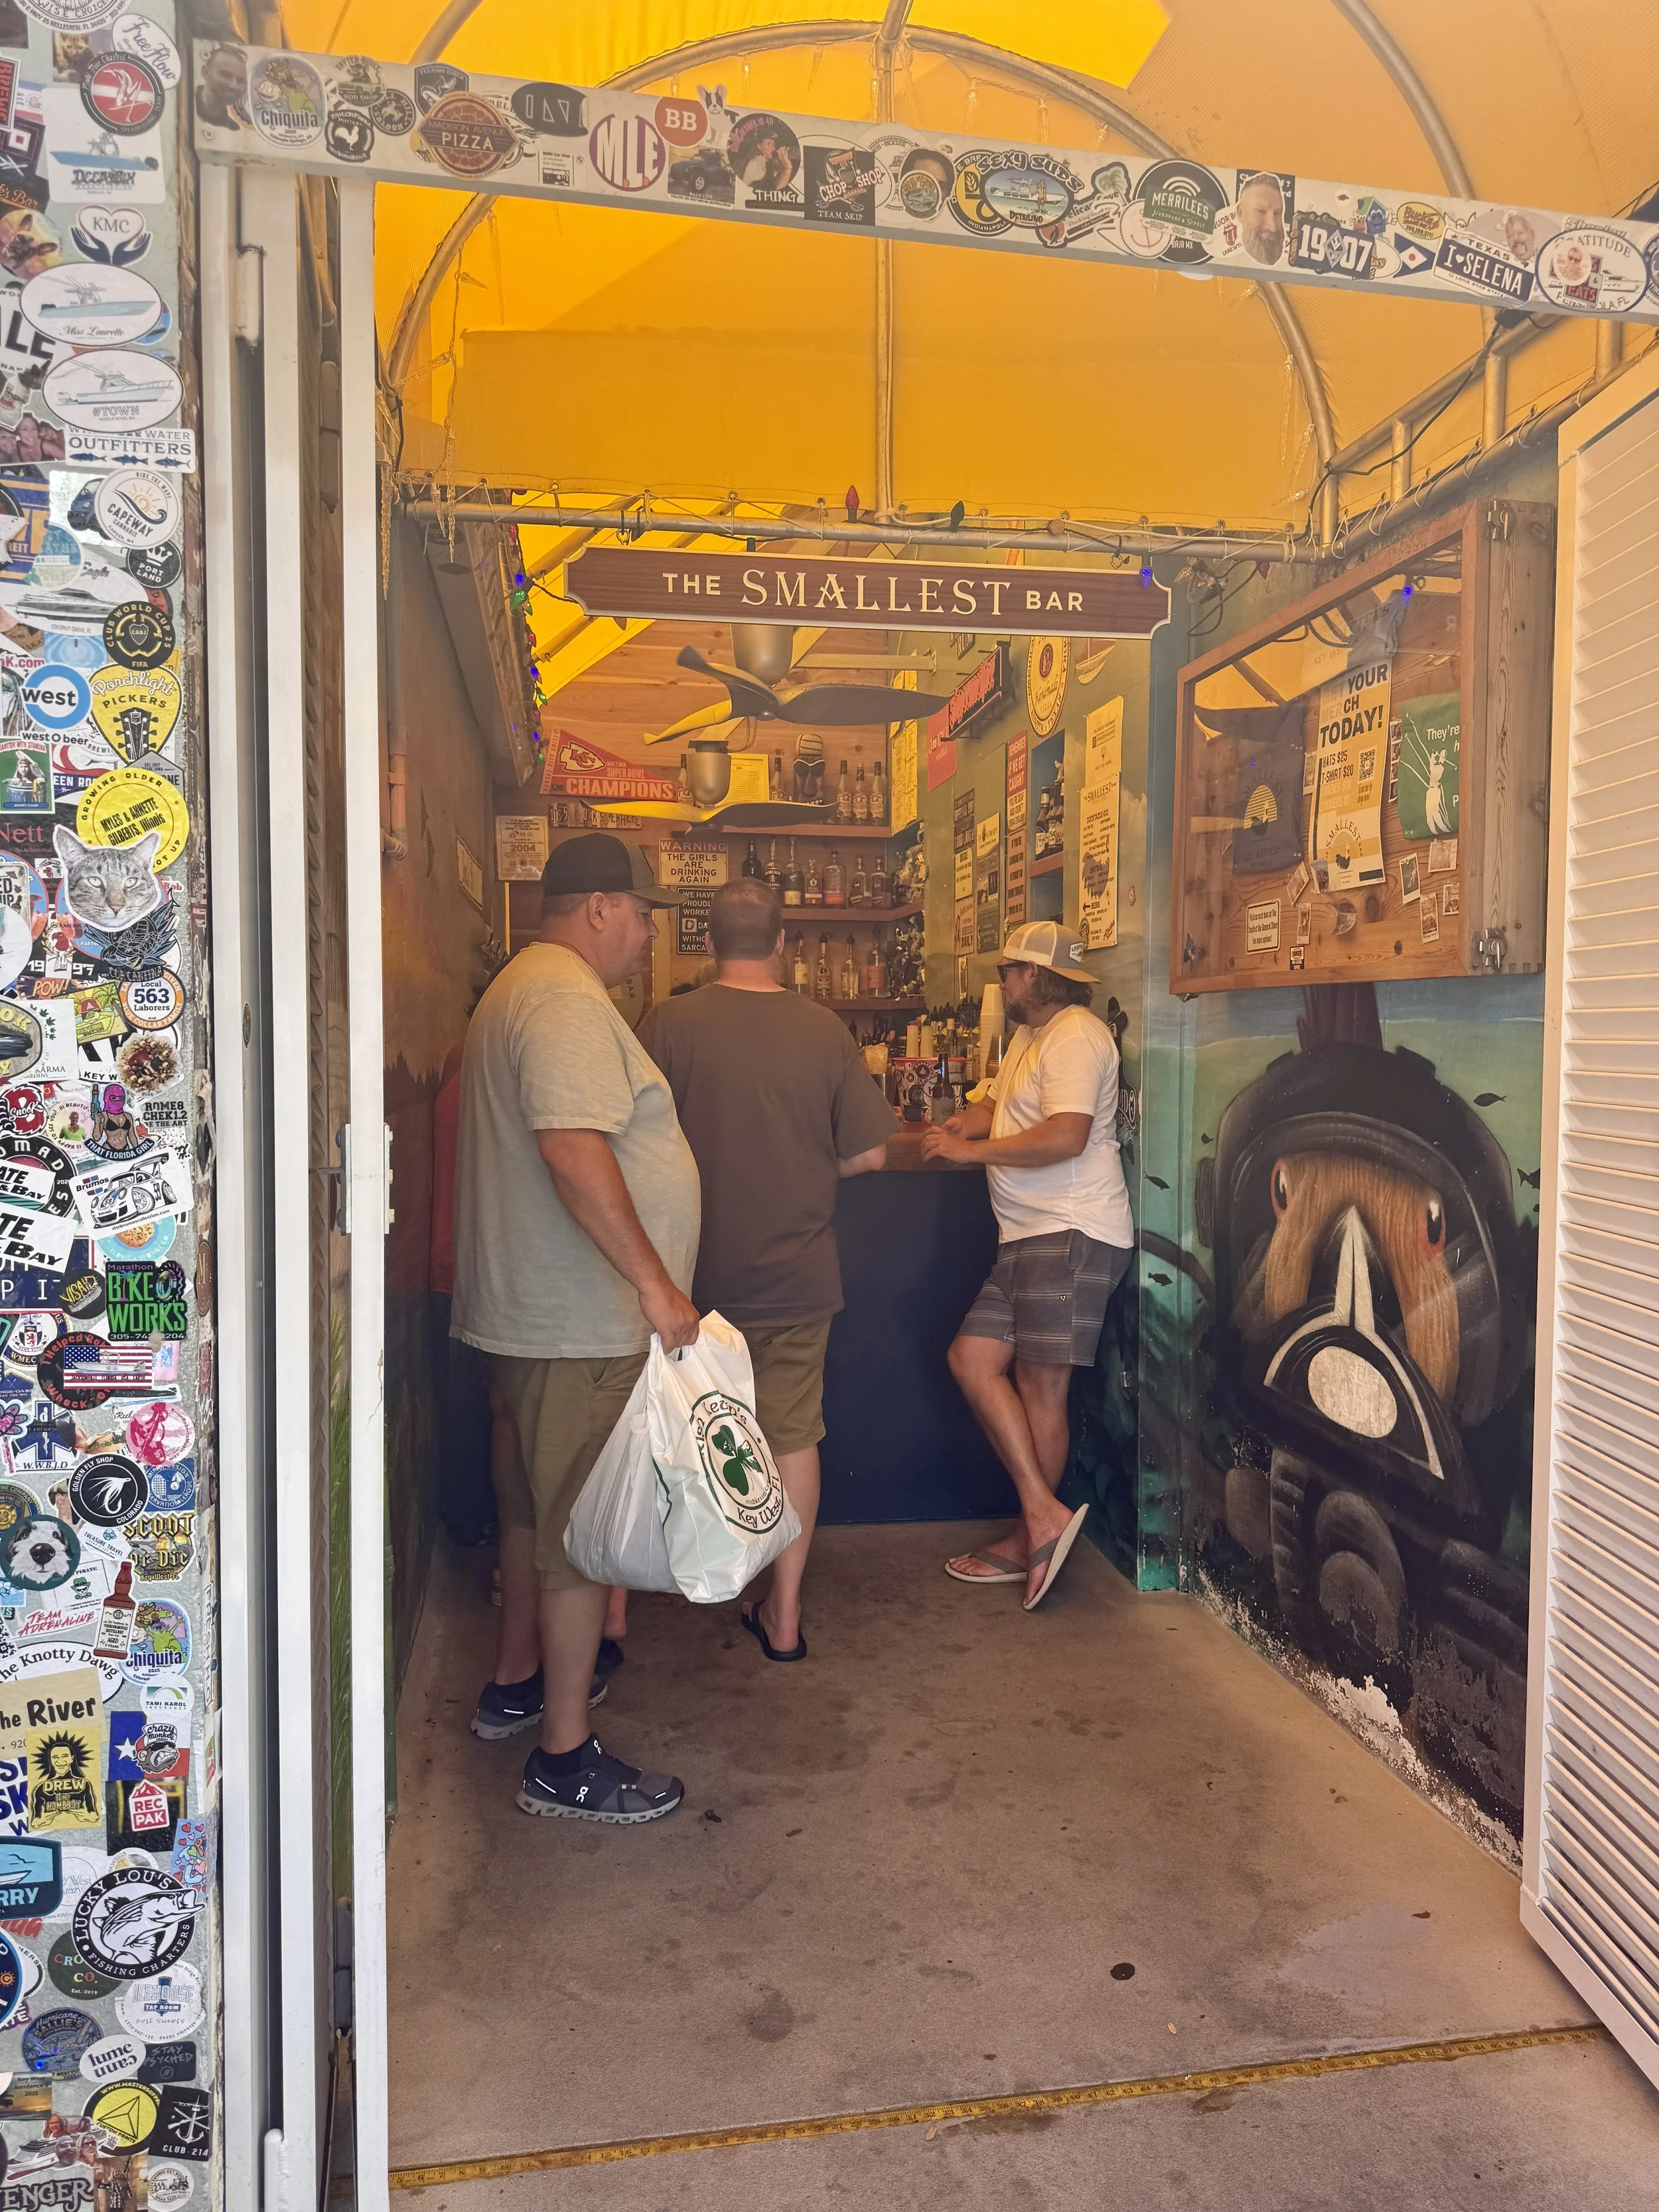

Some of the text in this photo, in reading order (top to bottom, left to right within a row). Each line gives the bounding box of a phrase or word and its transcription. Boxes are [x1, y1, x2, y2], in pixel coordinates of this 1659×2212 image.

[38, 0, 68, 18] WISE
[123, 17, 151, 52] Free
[261, 110, 319, 129] Chiquita
[428, 120, 506, 137] MADISON AVENUE
[664, 107, 697, 131] BB
[442, 131, 494, 151] PIZZA
[975, 151, 1085, 193] SEXY SUDS
[820, 167, 883, 202] CHOP SHOP
[755, 189, 798, 204] THING
[1151, 192, 1209, 220] MERRILEES
[93, 216, 131, 234] KMC
[818, 210, 863, 222] TEAM SKIP
[1171, 240, 1194, 250] BAJA MX
[1467, 238, 1511, 261] TEXAS
[1455, 275, 1486, 291] LONE STAR
[1465, 251, 1524, 296] SELENA
[1565, 285, 1597, 302] EATS
[146, 430, 190, 441] WATER
[69, 437, 192, 456] OUTFITTERS
[107, 502, 154, 538] CAPEWAY
[137, 569, 162, 583] LAND
[139, 563, 165, 577] PORT
[662, 569, 1084, 617] THE SMALLEST BAR
[106, 604, 173, 649] CLUB WORLD CUP 25
[92, 670, 177, 697] Porchlight
[1348, 663, 1389, 696] YOUR
[22, 688, 77, 707] west
[102, 694, 167, 709] PICKERS
[1320, 704, 1384, 749] TODAY!
[1426, 724, 1459, 742] They're
[22, 733, 90, 746] west beer
[1322, 749, 1348, 769] HATS $25
[607, 768, 646, 780] SUPER BOWL
[1321, 764, 1354, 785] T-SHIRT $20
[81, 773, 163, 821] GROWING OLDER
[565, 778, 674, 799] CHAMPIONS
[1086, 782, 1112, 802] SMALLEST
[100, 796, 160, 833] MYLES & ANNETTE
[108, 812, 167, 847] GILBERTS, Illinois
[1325, 819, 1362, 850] SMALLEST
[170, 838, 181, 853] UP
[510, 844, 536, 852] 2004
[660, 840, 727, 852] WARNING
[28, 959, 96, 976] 19 97
[32, 978, 69, 997] POW!
[134, 988, 169, 1004] 563
[134, 1001, 183, 1029] COLLAR FAMILY
[84, 1070, 105, 1081] KEY
[86, 1138, 153, 1160] THAT FLORIDA GIRL
[76, 1177, 109, 1193] Brumos
[108, 1302, 186, 1333] WORKS
[45, 1333, 83, 1359] Helped
[11, 1351, 36, 1363] WMEC
[46, 1384, 88, 1409] Whack
[72, 1468, 86, 1493] GOLDEN
[84, 1461, 95, 1471] FLY
[10, 1486, 34, 1504] COMPANY
[737, 1475, 783, 1529] Key West FL
[116, 1500, 144, 1524] COLORADO
[123, 1513, 194, 1538] SCOOT
[84, 1532, 106, 1548] TREASURE
[107, 1544, 124, 1557] TRAVEL
[17, 1611, 96, 1637] ADRENALINE
[27, 1609, 62, 1624] TEAM
[19, 1648, 120, 1681] Knotty Dawg
[26, 1698, 96, 1728] River
[44, 1779, 86, 1793] DREW
[46, 1800, 82, 1811] HOMEBOY
[134, 1797, 163, 1812] REC
[134, 1810, 165, 1826] PAK
[75, 1869, 173, 1943] LUCKY LOU'S
[87, 1953, 137, 1976] FISHING
[142, 1923, 190, 1974] CHARTERS
[73, 1971, 98, 1984] CO.
[133, 1984, 194, 2004] ICEHOUSE
[34, 2018, 84, 2037] SALLIE'S
[36, 2012, 79, 2028] Hurricane
[88, 2043, 134, 2067] lume
[143, 2052, 194, 2068] PSYCHED
[151, 2045, 183, 2057] STAY
[96, 2121, 137, 2144] CUSTOM PRINTS
[163, 2144, 186, 2154] CLUB
